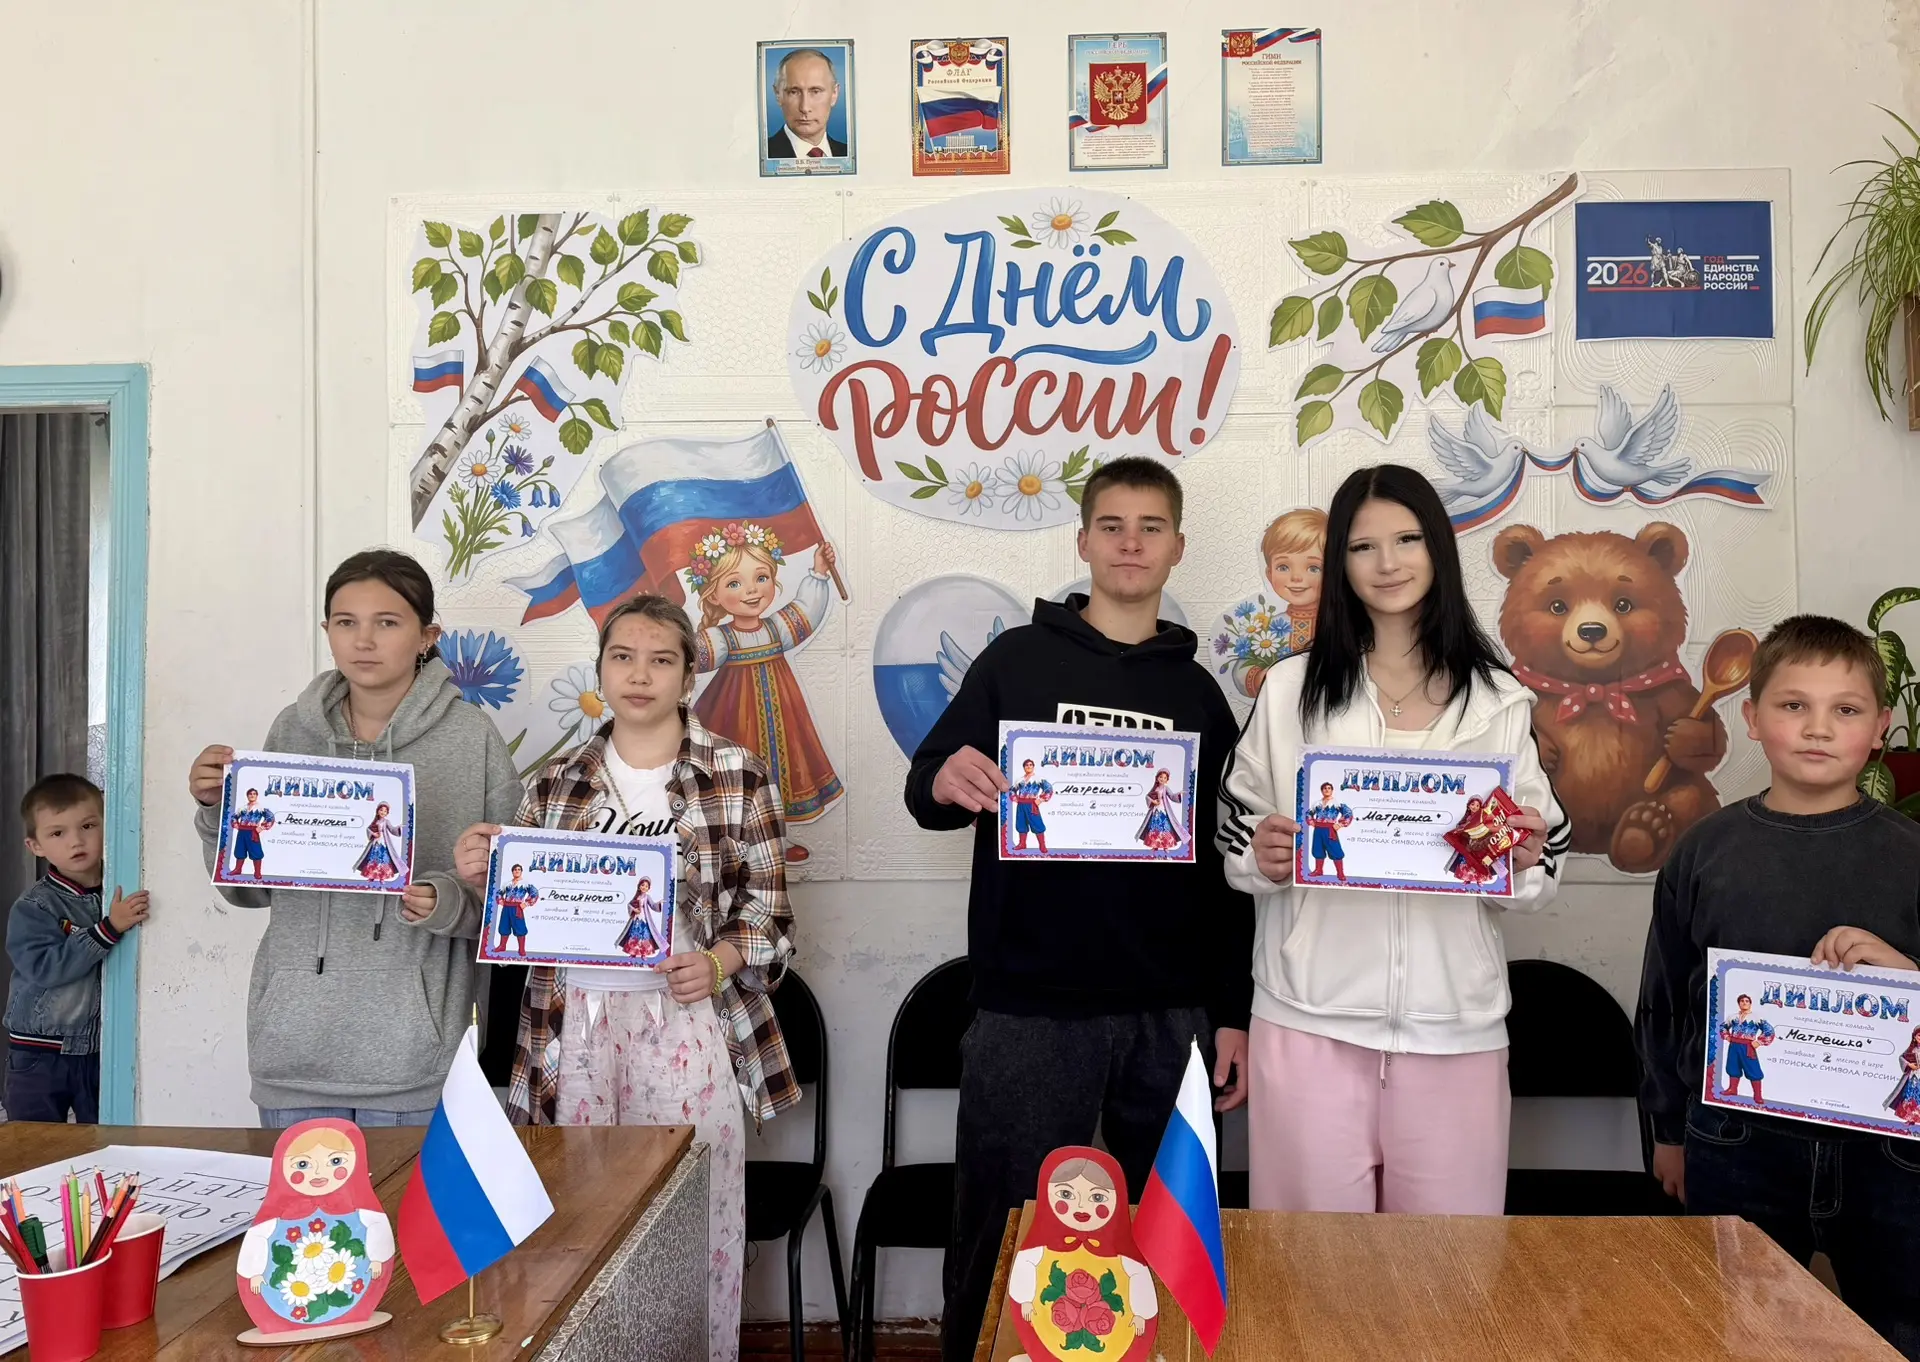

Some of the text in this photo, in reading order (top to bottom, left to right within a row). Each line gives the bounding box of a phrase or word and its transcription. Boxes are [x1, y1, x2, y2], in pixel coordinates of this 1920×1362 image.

[946, 69, 973, 77] ФЛАГ
[1703, 256, 1725, 264] ГОД
[1703, 264, 1760, 273] ЕДИНСТВА
[1587, 262, 1649, 285] 2026
[1703, 273, 1755, 283] НАРОДОВ
[844, 226, 1212, 356] С Днём
[1703, 283, 1748, 291] РОССИИ
[818, 333, 1231, 481] России!
[1041, 745, 1156, 768] ДИПЛОМ
[264, 774, 375, 801] ДИПЛОМ
[1340, 768, 1466, 795] ДИПЛОМ
[529, 850, 637, 876] ДИПЛОМ
[1760, 981, 1910, 1022] ДИПЛОМ
[1779, 1057, 1818, 1070] ПОИСКАХ
[1819, 1064, 1860, 1076] СИМВОЛА
[1822, 1052, 1832, 1063] 2
